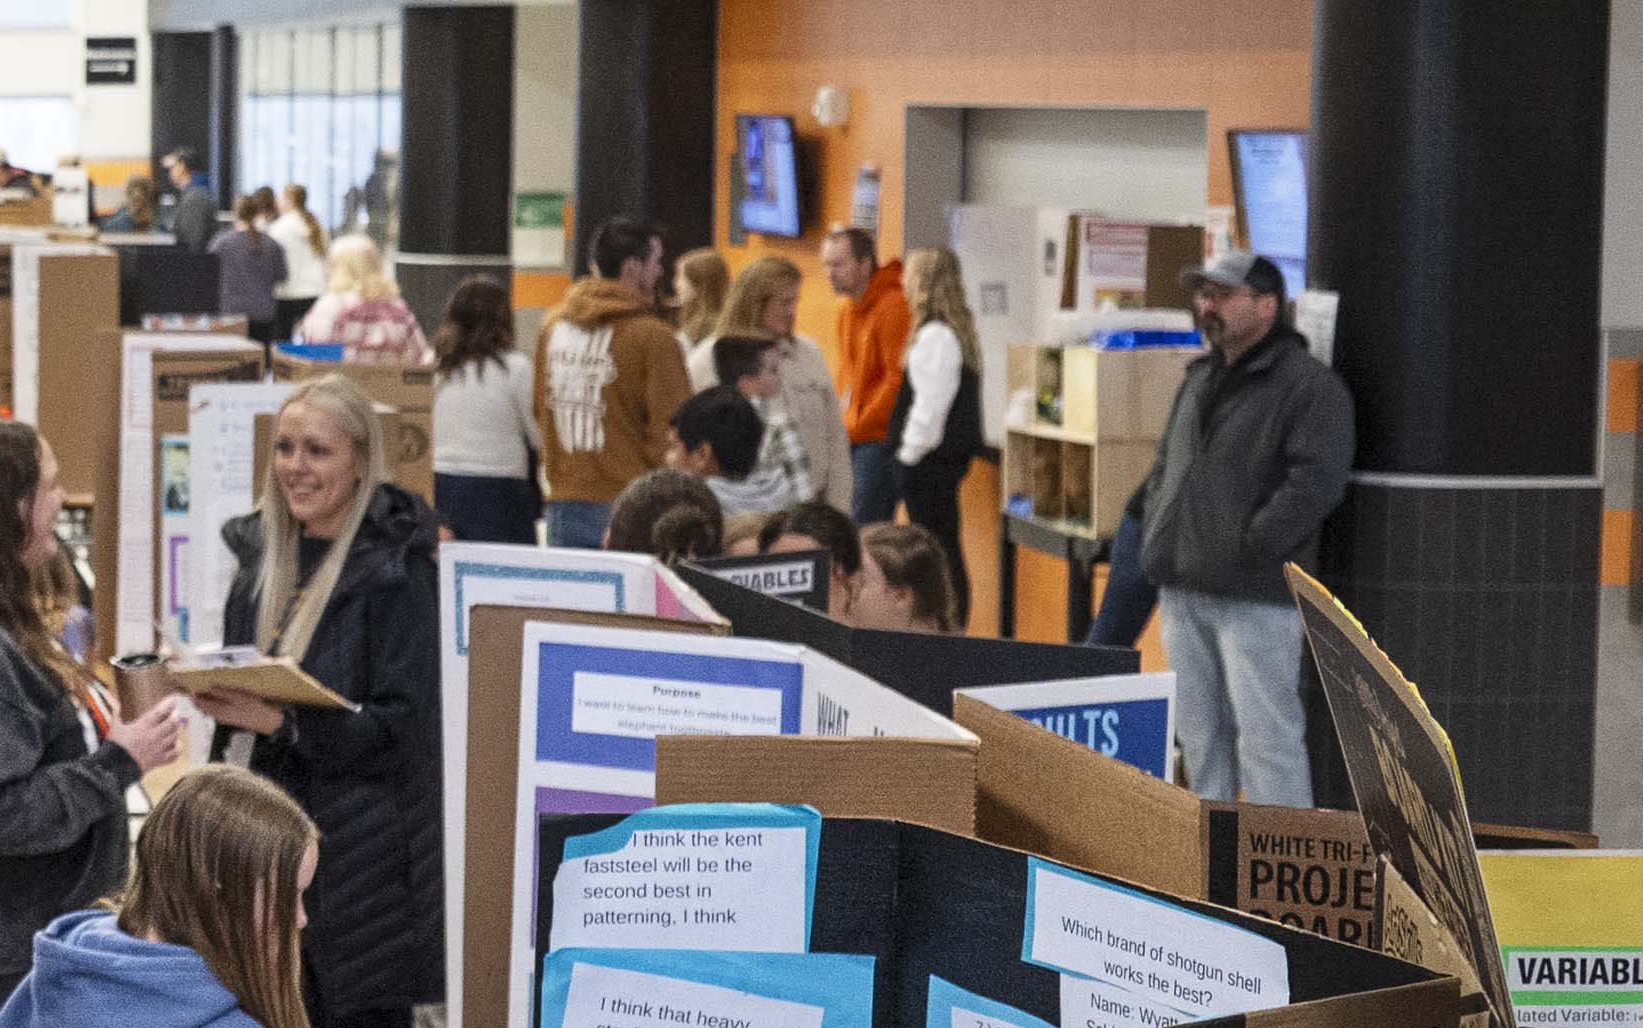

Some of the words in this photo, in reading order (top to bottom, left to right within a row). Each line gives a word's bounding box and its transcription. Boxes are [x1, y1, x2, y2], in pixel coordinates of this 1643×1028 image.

[731, 567, 811, 591] IABLES
[633, 831, 637, 847] I
[643, 831, 685, 846] think
[690, 831, 718, 846] the
[725, 831, 762, 846] kent
[1250, 833, 1315, 858] WHITE
[1321, 840, 1370, 863] TRI-F
[583, 857, 657, 873] faststeel
[663, 857, 690, 872] will
[696, 857, 718, 872] be
[724, 857, 752, 872] the
[583, 883, 647, 899] second
[653, 883, 690, 898] best
[696, 886, 711, 897] in
[1250, 858, 1372, 911] PROJE
[683, 909, 687, 923] I
[694, 908, 736, 923] think
[1061, 916, 1102, 942] Which
[1107, 929, 1145, 956] brand
[1149, 946, 1163, 962] of
[1167, 951, 1223, 982] shotgun
[1227, 970, 1261, 994] shell
[1104, 961, 1144, 984] works
[1147, 972, 1169, 993] the
[1173, 979, 1212, 1005] best?
[1517, 957, 1643, 985] VARIABL
[600, 997, 605, 1010] I
[611, 998, 652, 1017] think
[658, 1005, 691, 1024] that
[1091, 993, 1135, 1020] Name:
[1562, 1009, 1630, 1023] Variable:
